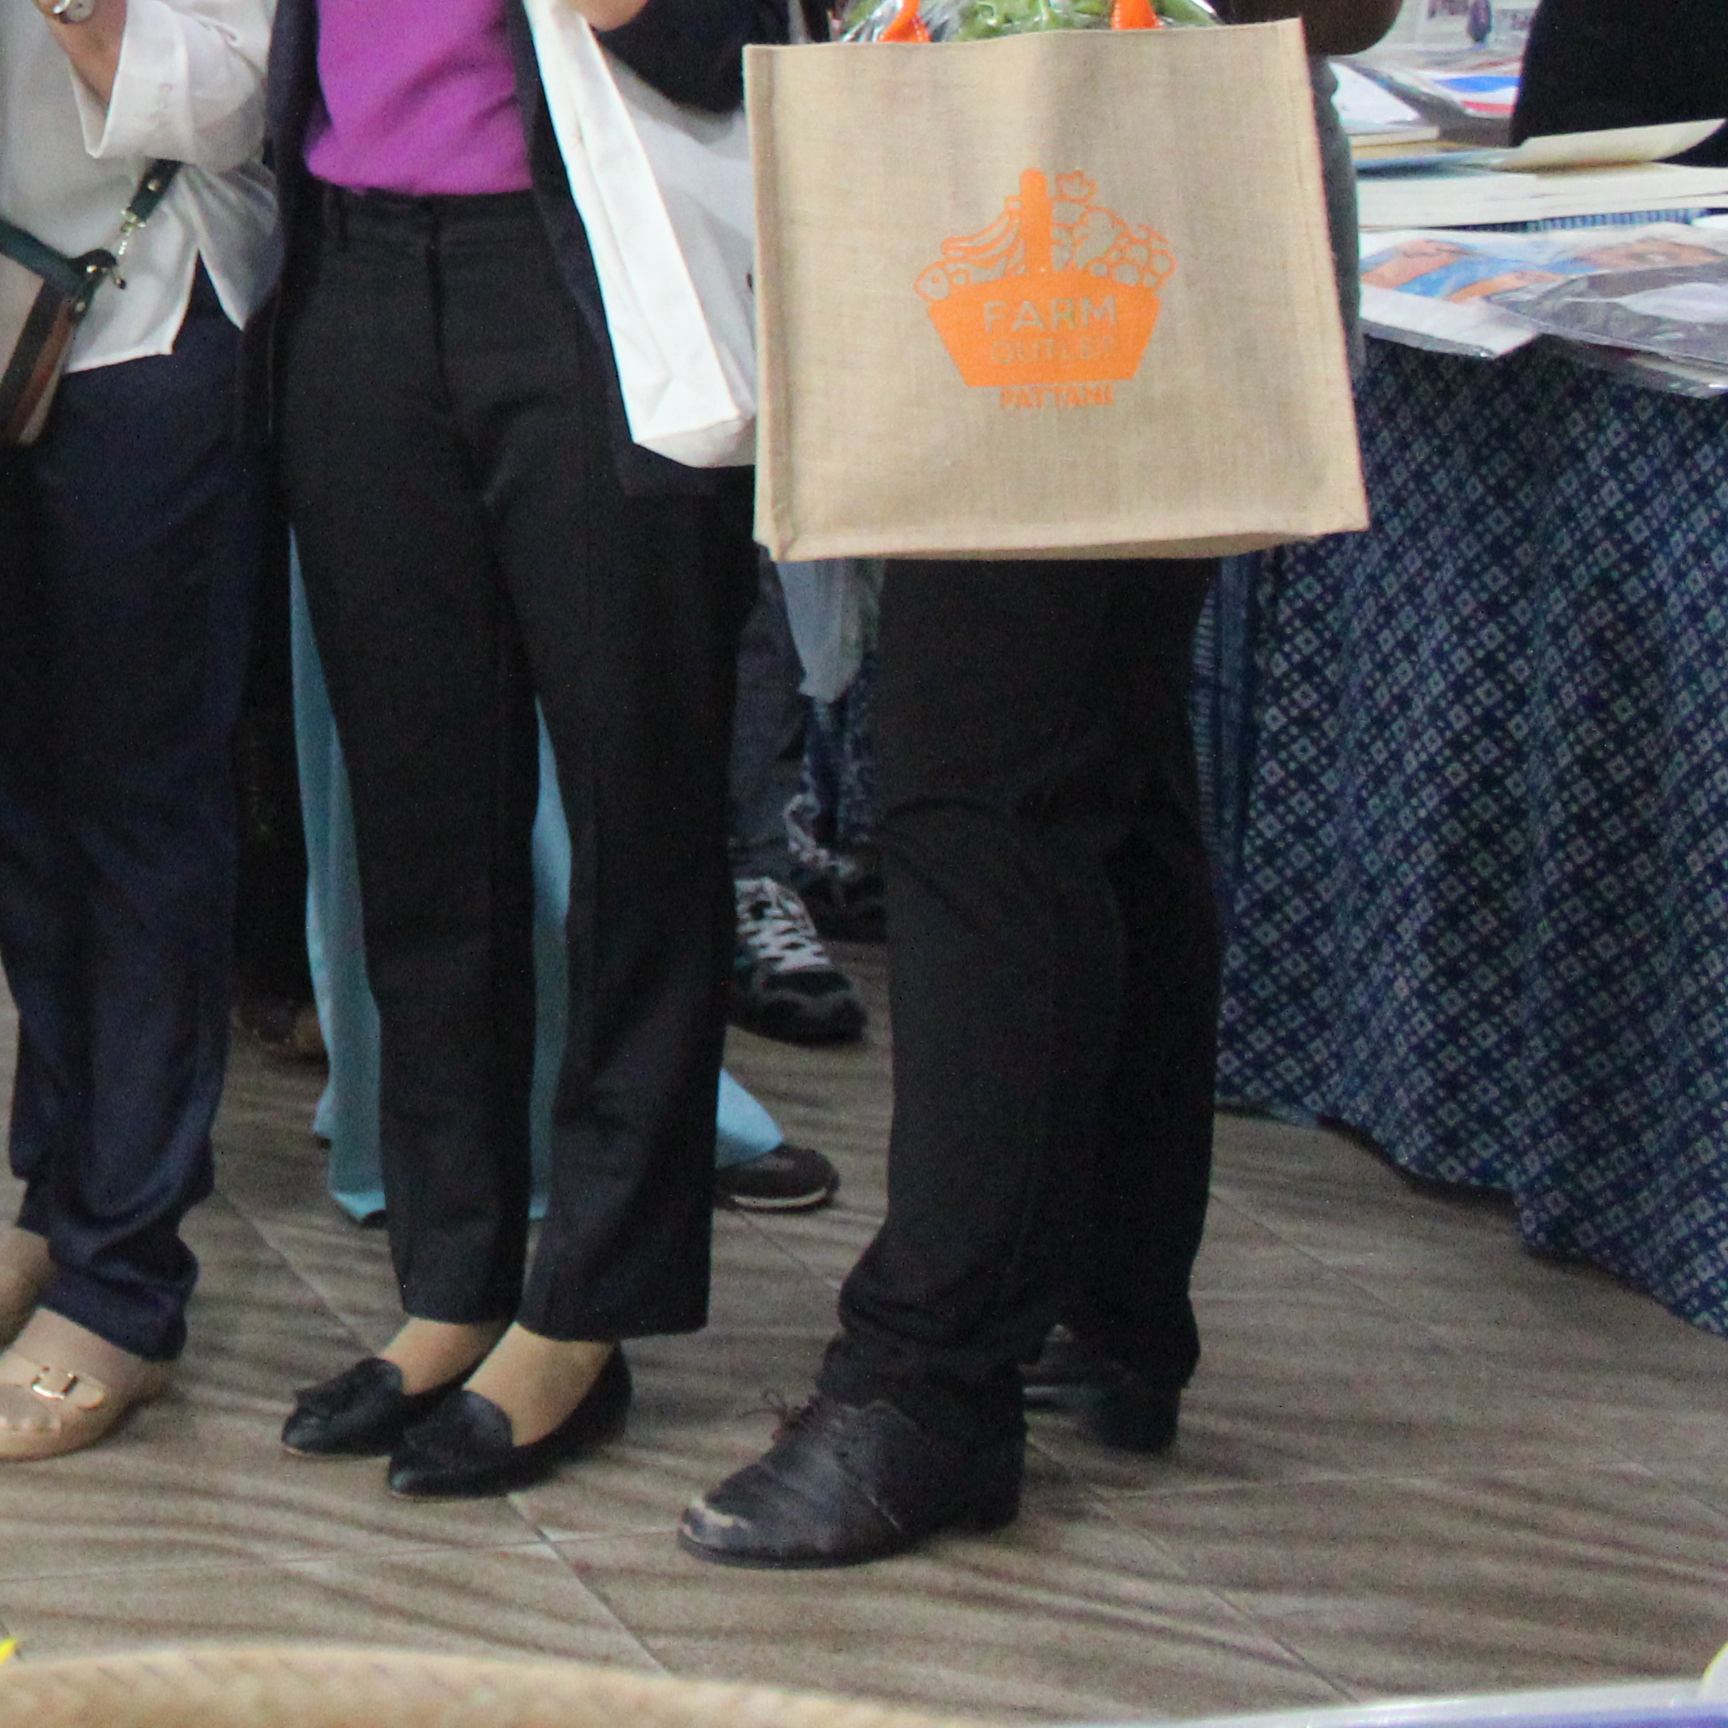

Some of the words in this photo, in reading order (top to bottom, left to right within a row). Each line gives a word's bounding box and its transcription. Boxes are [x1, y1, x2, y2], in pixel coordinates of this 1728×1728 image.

[983, 294, 1119, 334] FARM
[990, 335, 1117, 364] OUTLET
[999, 383, 1115, 410] PATTANI
